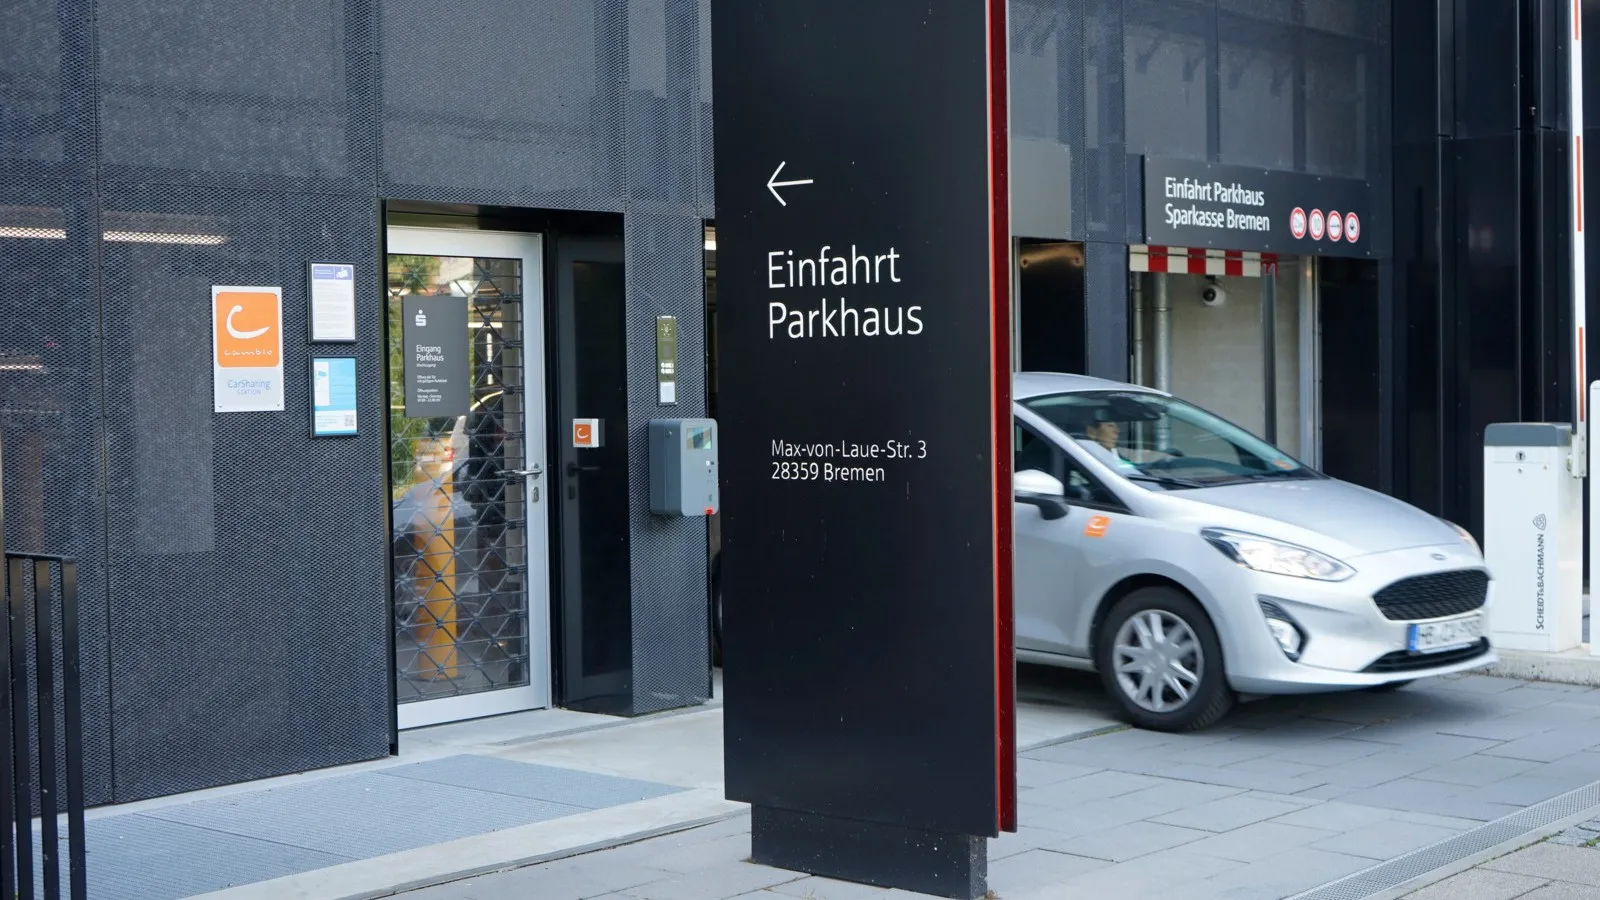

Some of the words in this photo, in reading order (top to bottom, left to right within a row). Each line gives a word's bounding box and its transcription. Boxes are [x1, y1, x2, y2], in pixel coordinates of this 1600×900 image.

[1165, 177, 1212, 201] Einfahrt
[1214, 182, 1265, 206] Parkhaus
[1165, 203, 1225, 229] Sparkasse
[1227, 208, 1270, 231] Bremen
[768, 244, 901, 288] Einfahrt
[769, 297, 924, 339] Parkhaus
[416, 344, 441, 355] Eingang
[416, 353, 444, 362] Parkhaus
[227, 379, 271, 390] CarSharing
[771, 439, 912, 459] Max-von-Laue-Str.
[917, 440, 927, 459] 3
[771, 461, 819, 480] 28359
[824, 462, 885, 482] Bremen
